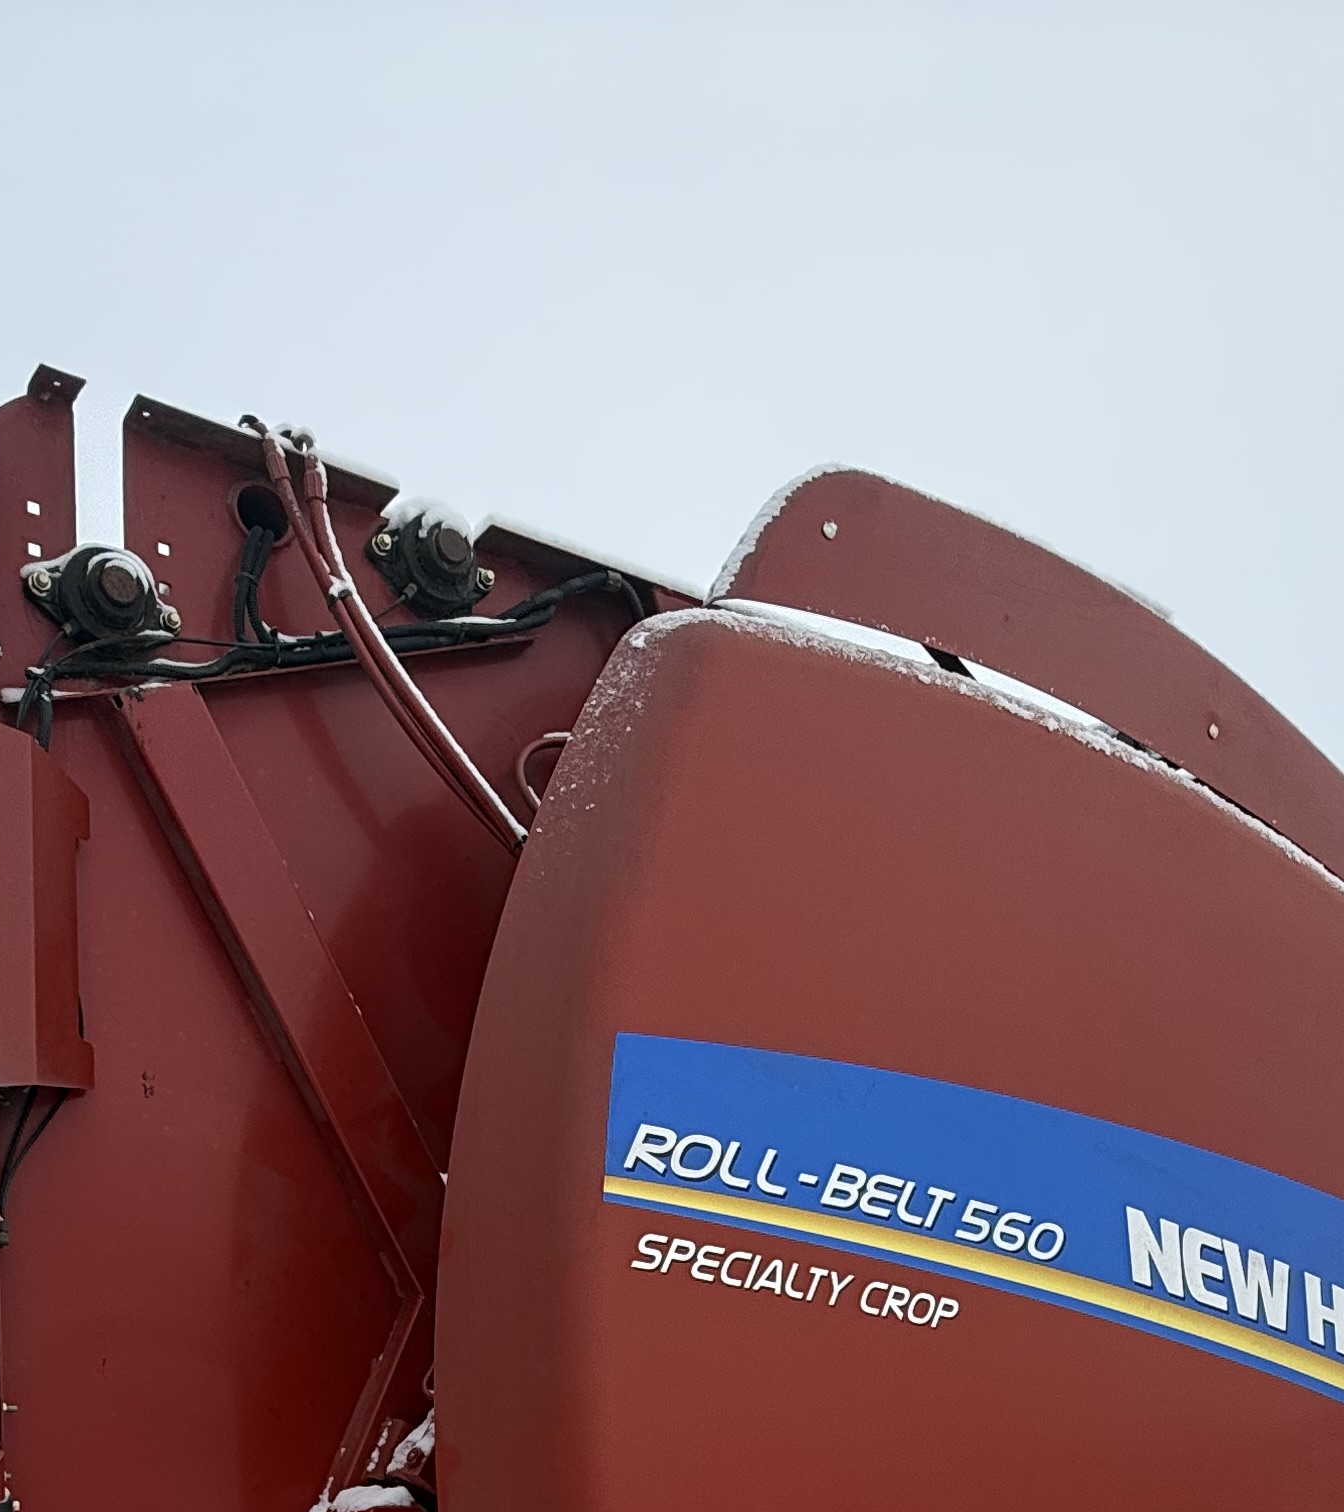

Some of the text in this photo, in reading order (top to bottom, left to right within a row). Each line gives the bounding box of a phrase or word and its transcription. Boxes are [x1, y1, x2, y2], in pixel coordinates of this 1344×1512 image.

[955, 1199, 1066, 1261] 560
[1126, 1206, 1291, 1332] NEW
[630, 1233, 960, 1329] SPECIALTY CROP
